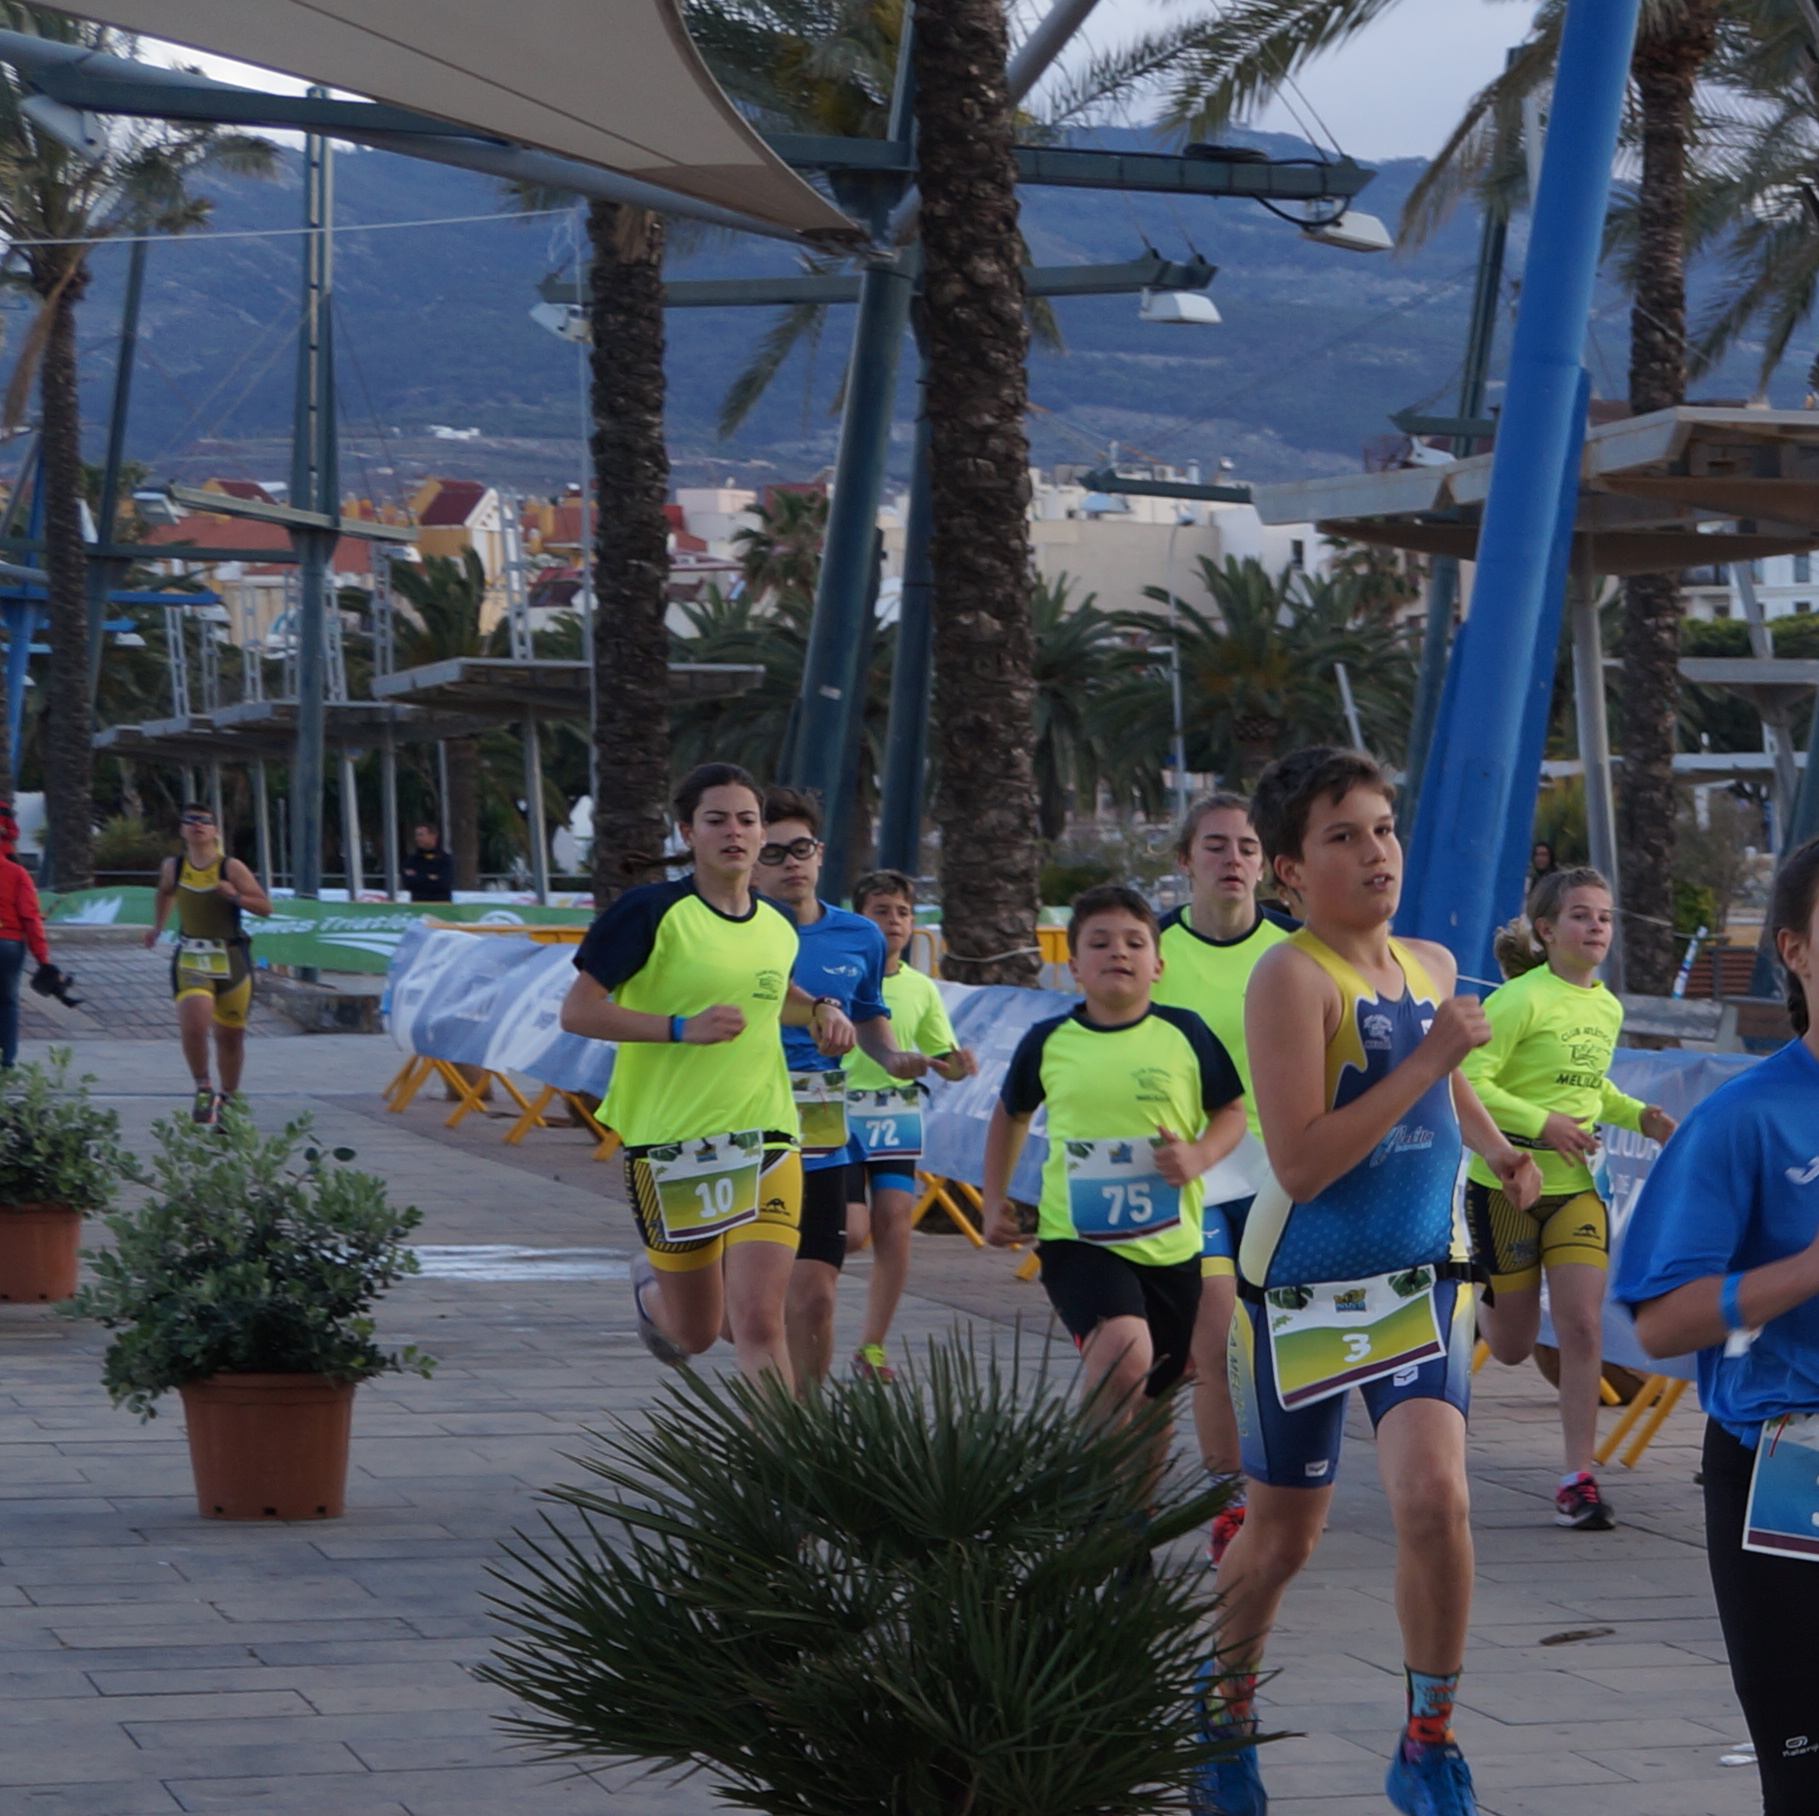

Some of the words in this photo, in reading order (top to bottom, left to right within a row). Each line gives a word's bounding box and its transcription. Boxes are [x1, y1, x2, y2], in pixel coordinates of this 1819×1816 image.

[866, 1119, 899, 1147] 72
[695, 1178, 734, 1218] 10
[1102, 1182, 1153, 1225] 75
[1342, 1333, 1371, 1362] 3
